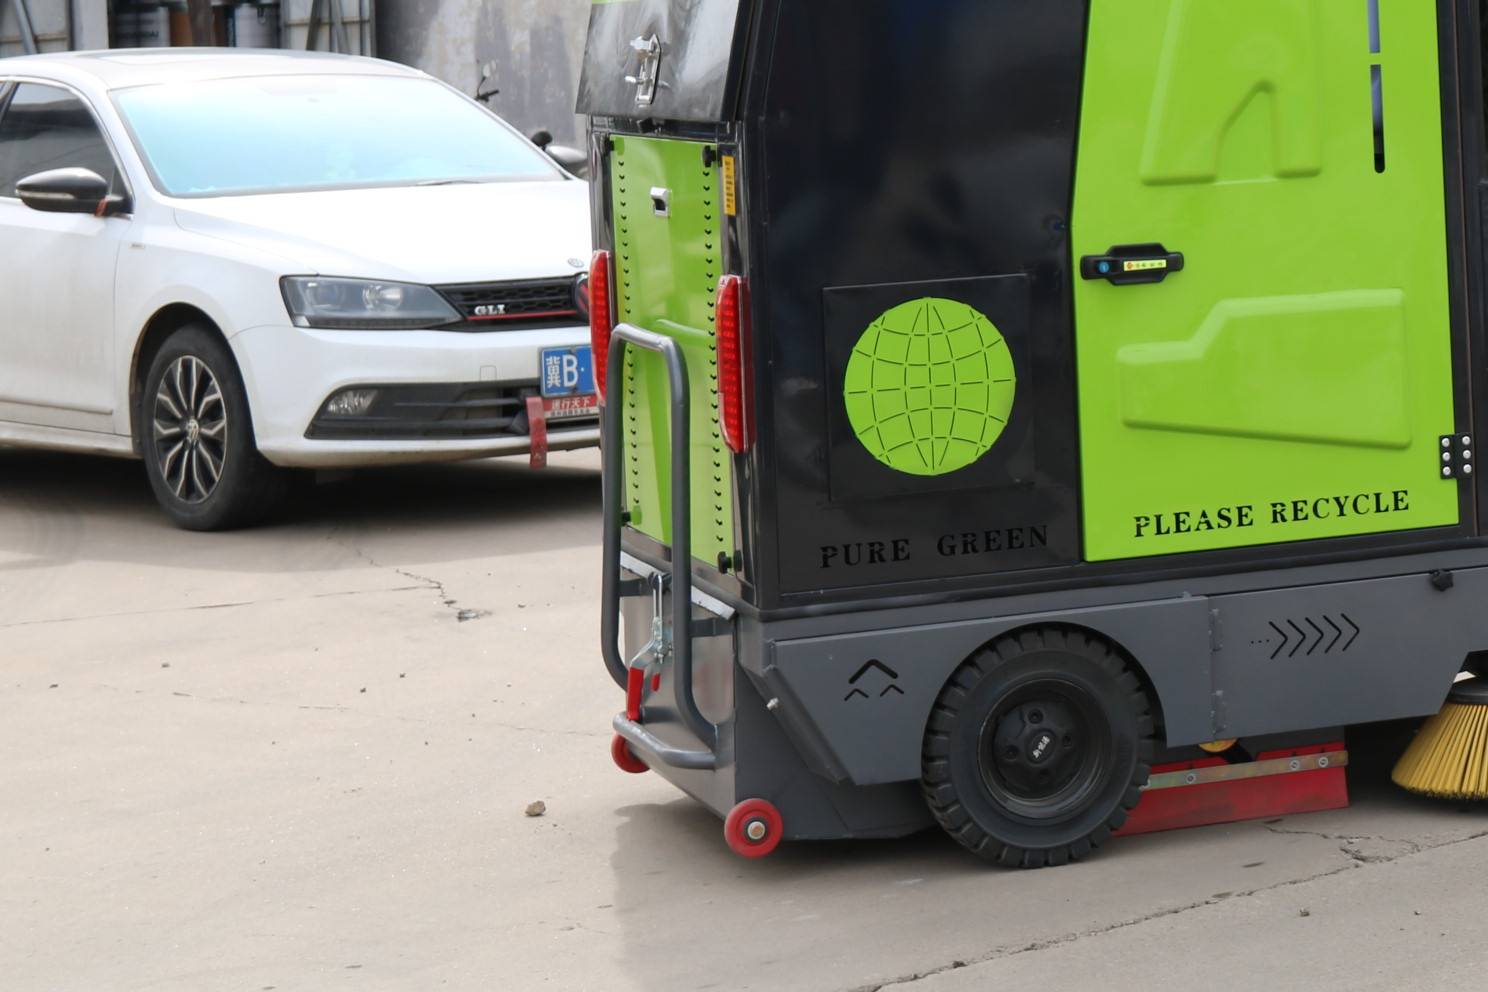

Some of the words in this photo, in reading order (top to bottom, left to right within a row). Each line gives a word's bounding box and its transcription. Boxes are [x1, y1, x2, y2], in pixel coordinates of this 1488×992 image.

[474, 304, 506, 316] GLI
[1133, 504, 1255, 538] PLEASE
[1270, 489, 1409, 524] RECYCLE
[819, 537, 911, 569] PURE
[936, 524, 1049, 558] GREEN
